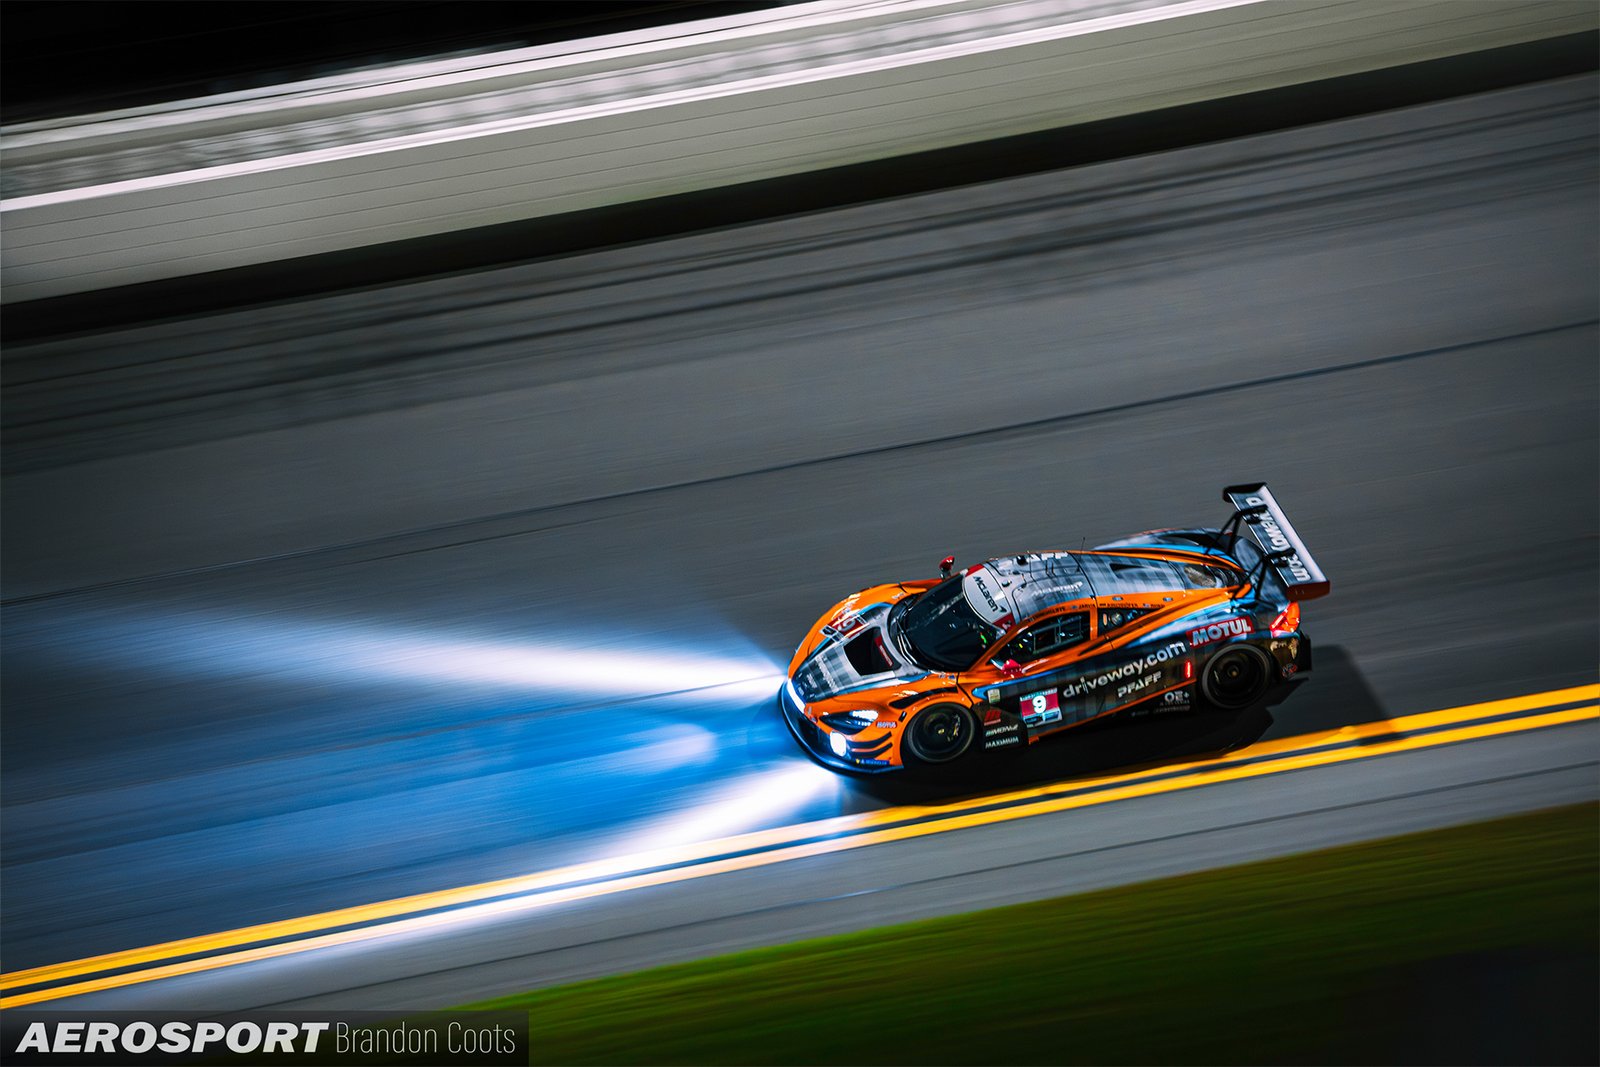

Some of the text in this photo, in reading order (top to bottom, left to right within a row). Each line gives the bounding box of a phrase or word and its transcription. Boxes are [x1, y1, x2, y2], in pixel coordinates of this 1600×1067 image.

[973, 576, 999, 612] McLaren
[1192, 618, 1252, 647] MOTUL
[1063, 641, 1186, 699] driveway.com
[1117, 671, 1162, 698] PFAFF
[1032, 695, 1047, 714] 9
